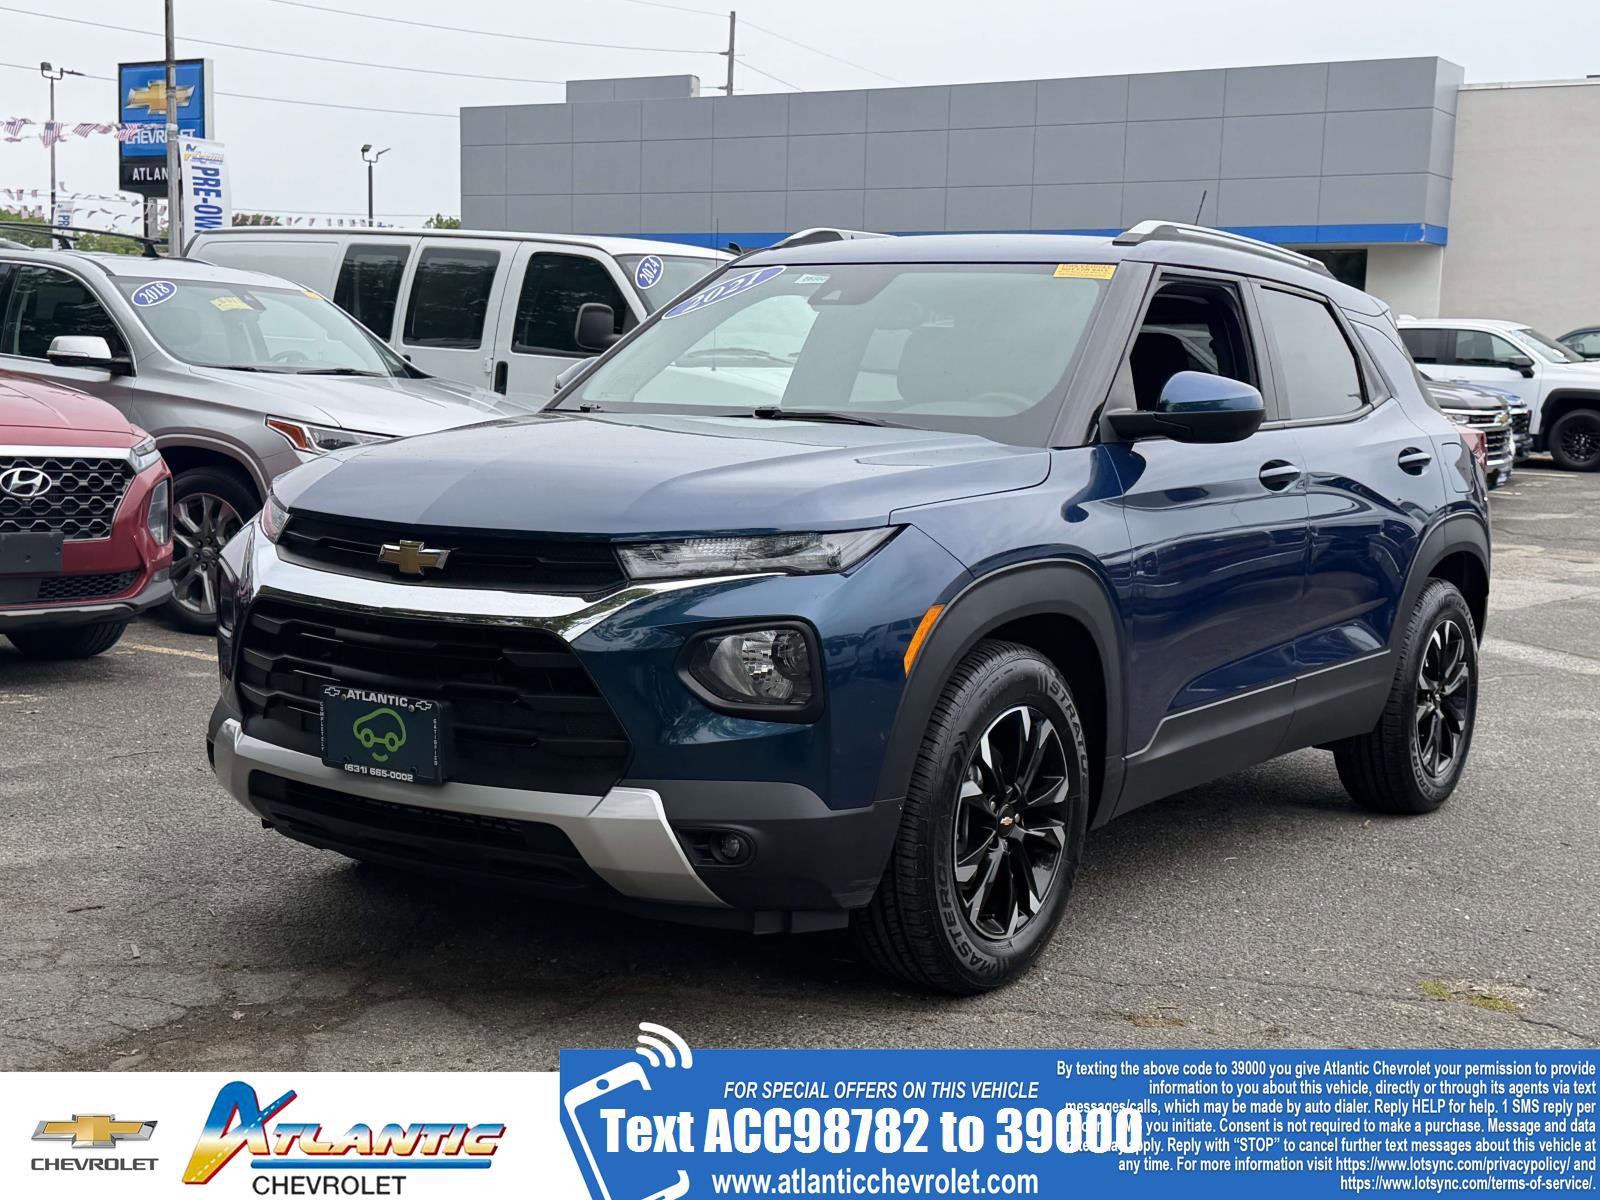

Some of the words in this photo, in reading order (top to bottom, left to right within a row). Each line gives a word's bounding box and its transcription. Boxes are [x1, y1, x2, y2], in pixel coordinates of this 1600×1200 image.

[192, 166, 222, 233] PRE-OW
[640, 257, 660, 284] 2024
[139, 282, 170, 304] 2018
[684, 271, 761, 312] 2021
[347, 690, 408, 707] ATLANTIC
[345, 763, 367, 774] (631)
[370, 767, 414, 782] 665-0002
